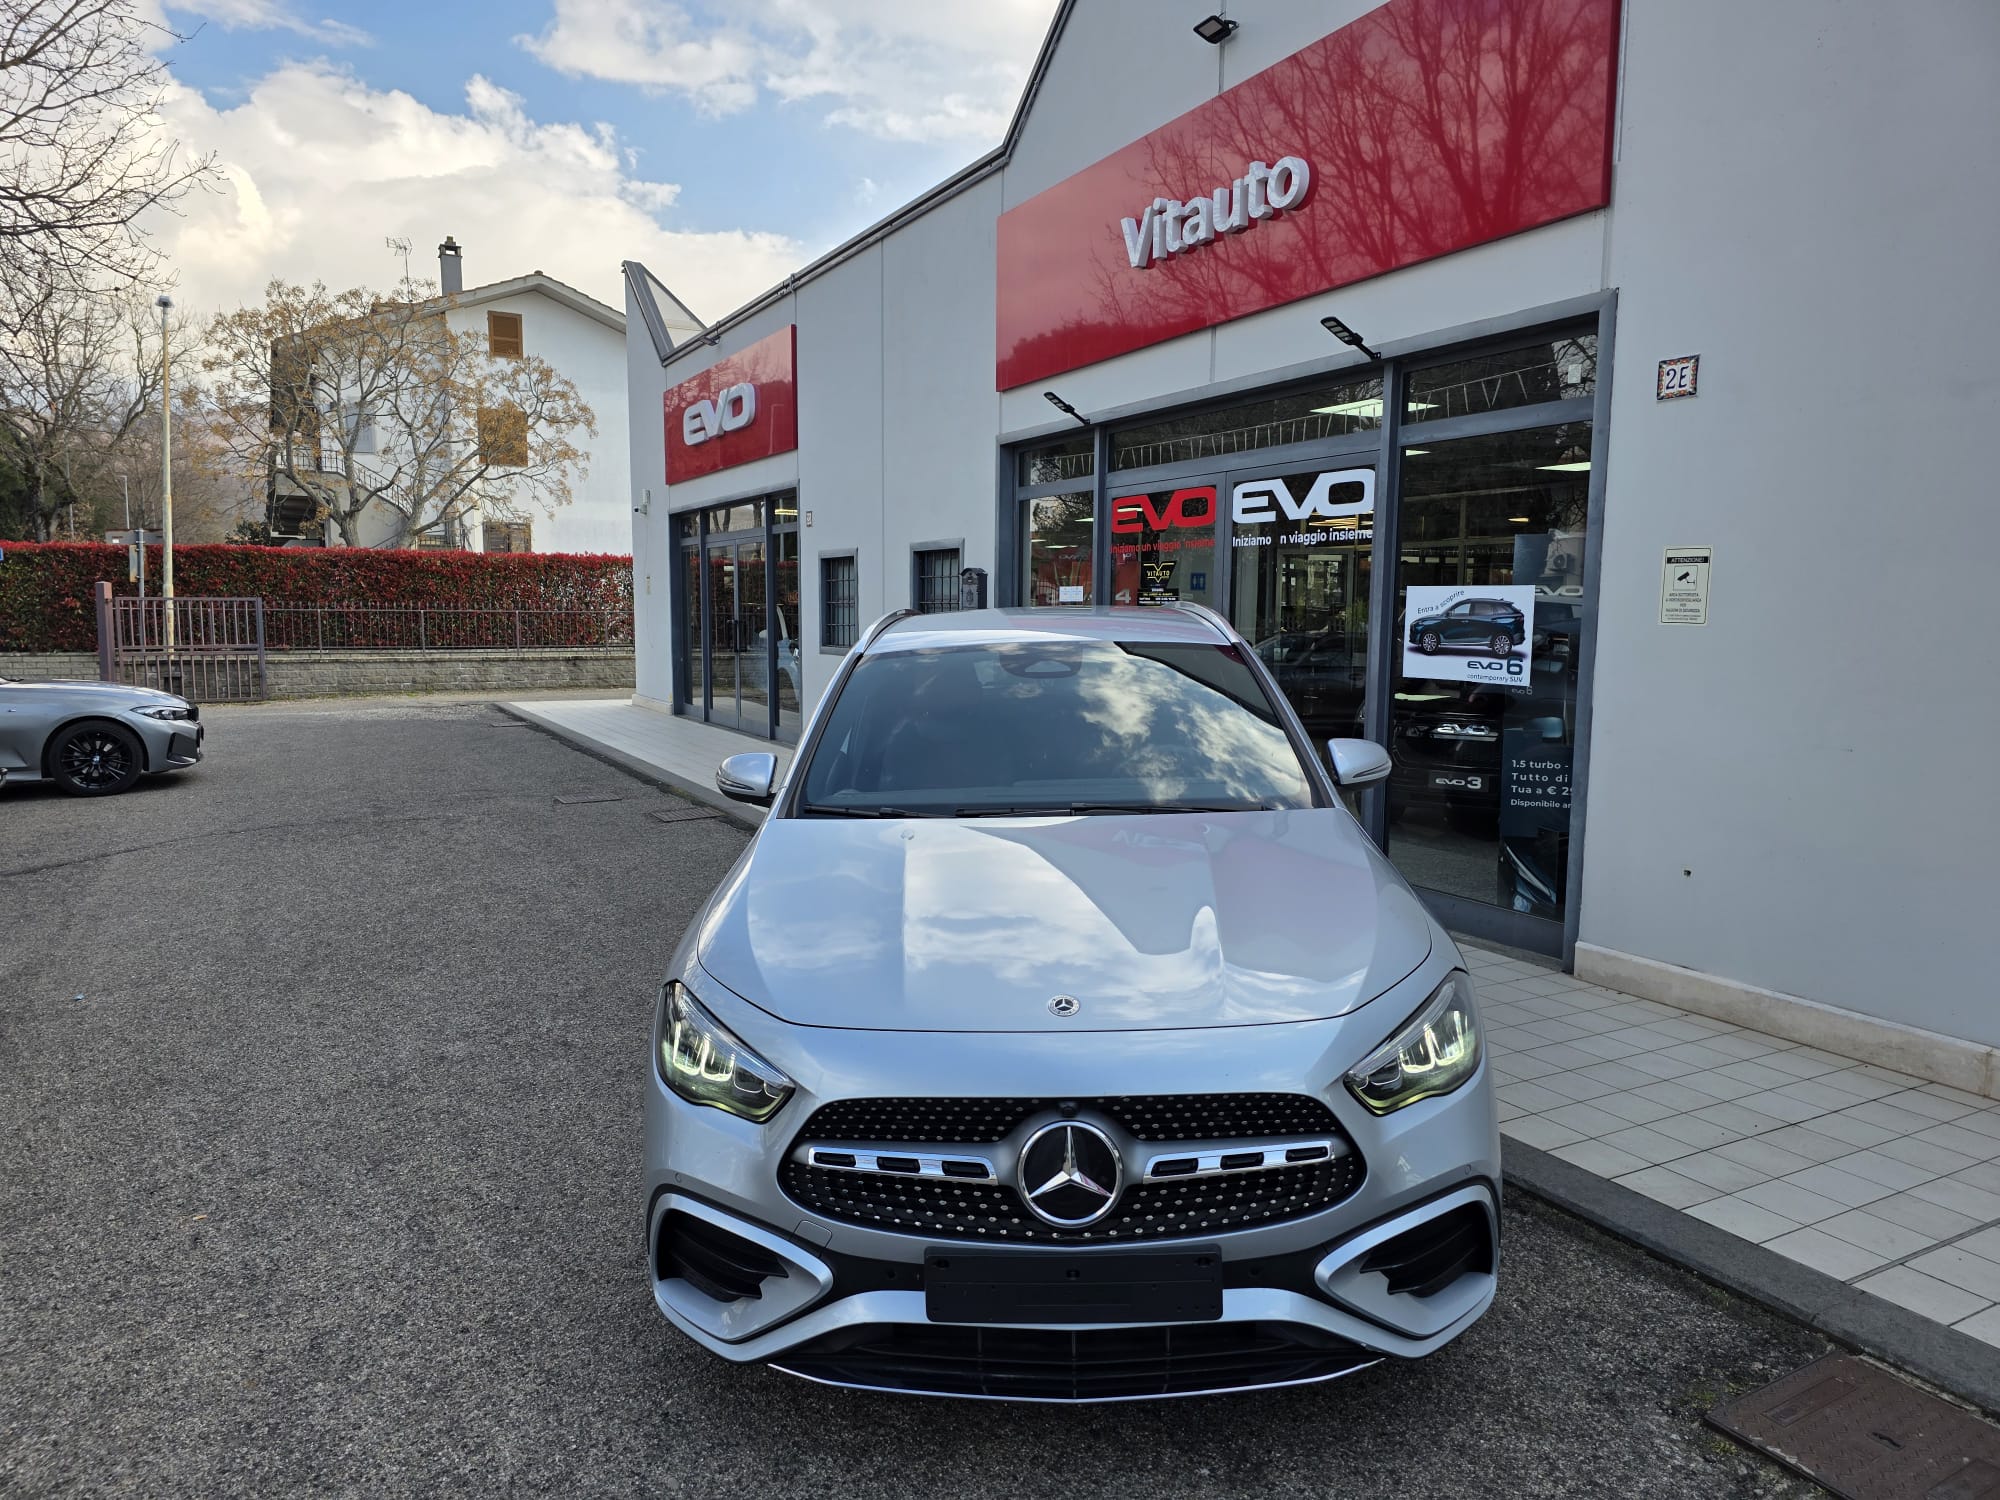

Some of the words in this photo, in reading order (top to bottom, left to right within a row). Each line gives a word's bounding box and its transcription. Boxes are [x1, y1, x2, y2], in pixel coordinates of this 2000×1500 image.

[1120, 155, 1310, 269] Vitauto
[1665, 366, 1690, 390] 2E
[683, 382, 756, 446] EVO
[1232, 468, 1376, 524] EVO
[1111, 486, 1217, 534] EVO
[1232, 534, 1272, 547] Iniziamo
[1289, 529, 1327, 546] viaggio
[1329, 528, 1373, 541] insieme
[1467, 660, 1504, 671] EVO
[1506, 656, 1524, 676] 6
[1511, 759, 1527, 768] 1.5
[1529, 760, 1562, 770] turbo
[1435, 777, 1466, 786] EVO
[1467, 776, 1482, 790] 3
[1511, 772, 1549, 782] Tutto
[1555, 774, 1568, 783] di
[1511, 785, 1532, 794] Tua
[1510, 799, 1561, 808] Disponibile
